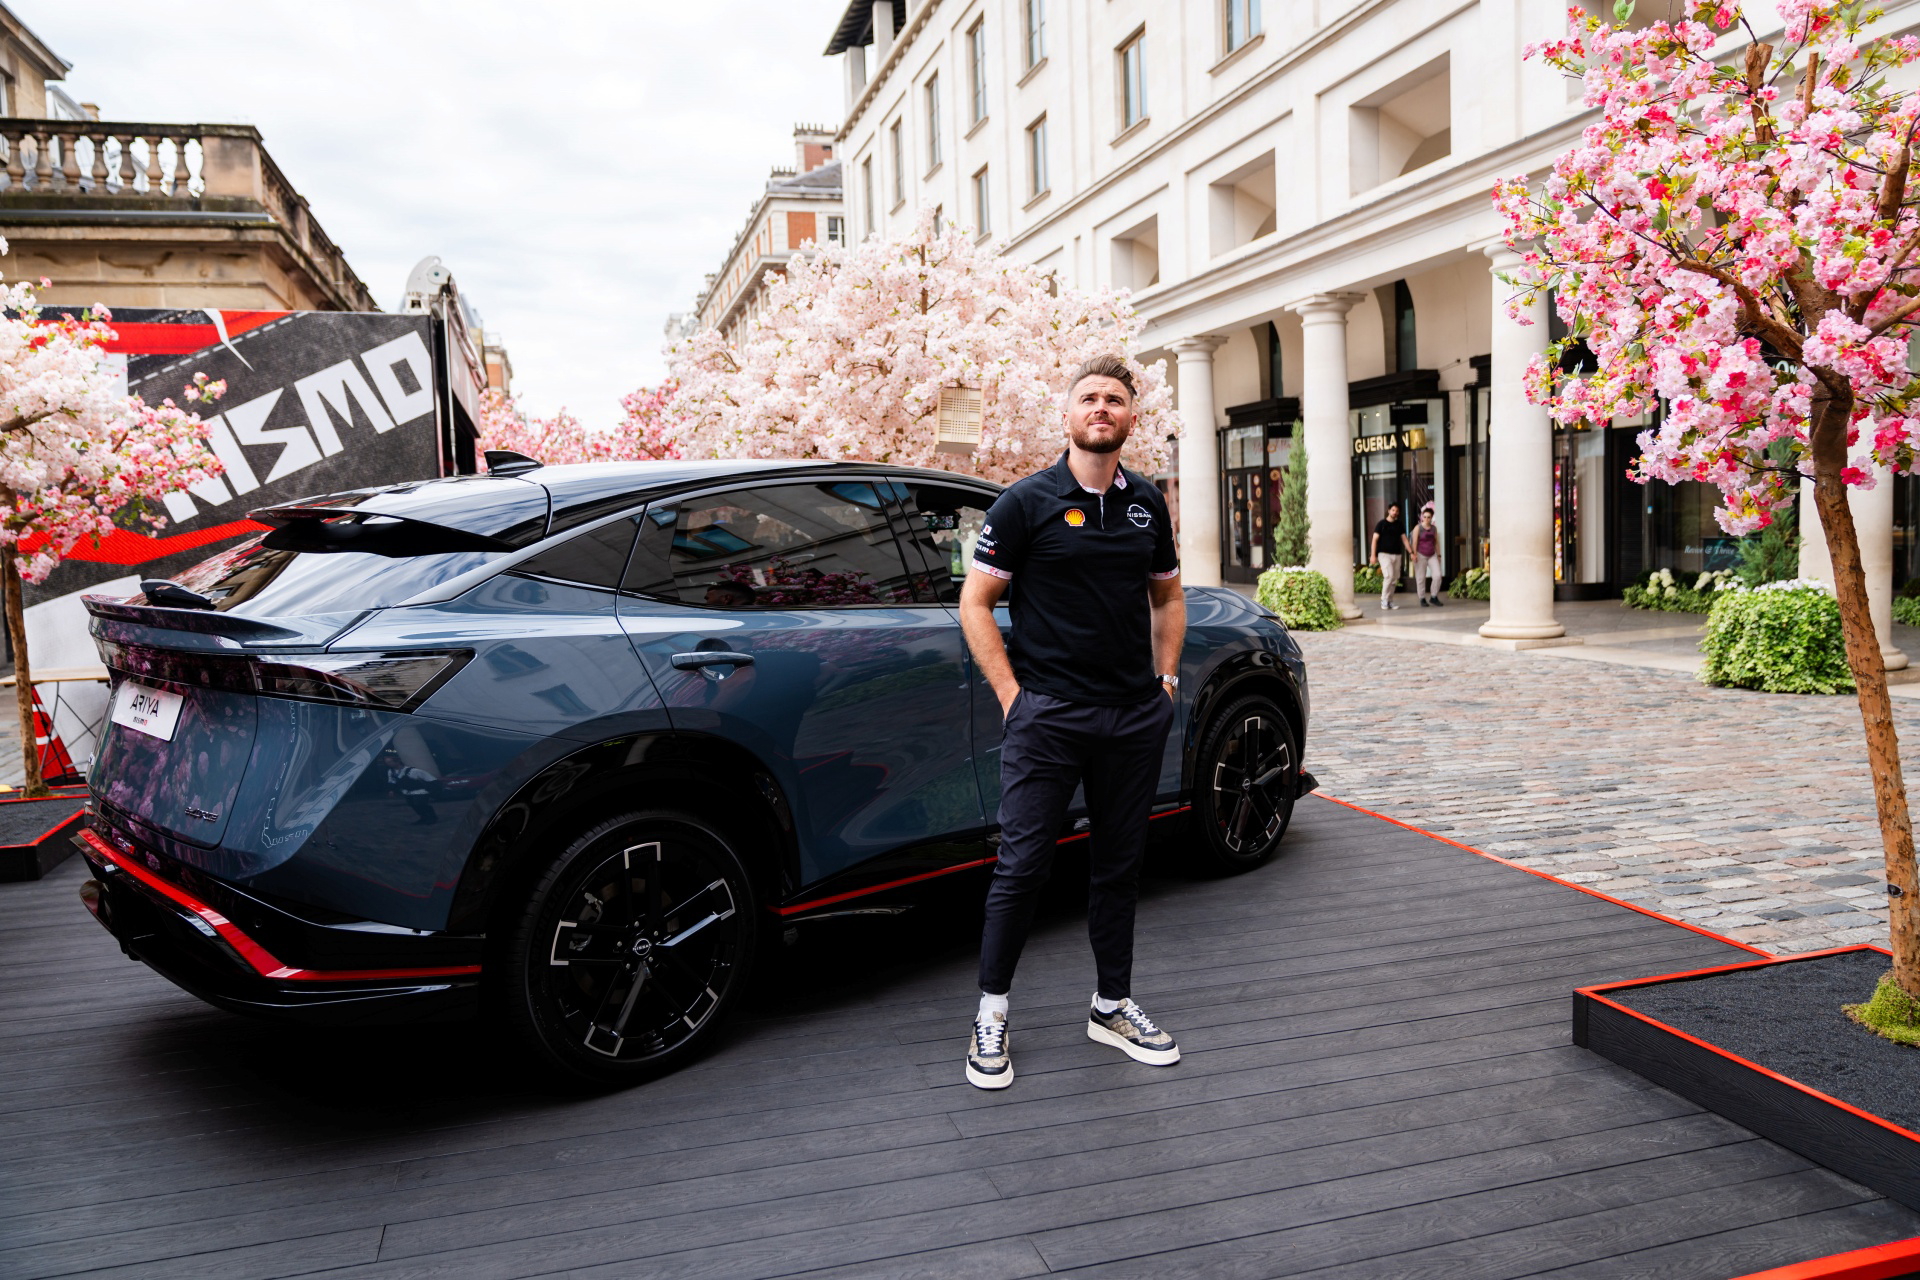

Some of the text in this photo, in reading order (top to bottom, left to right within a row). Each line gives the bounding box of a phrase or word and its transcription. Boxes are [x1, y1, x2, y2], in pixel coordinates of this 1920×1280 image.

[1355, 432, 1409, 453] GUERLAN
[1126, 512, 1152, 520] NISSAN
[130, 694, 159, 717] ARIYA
